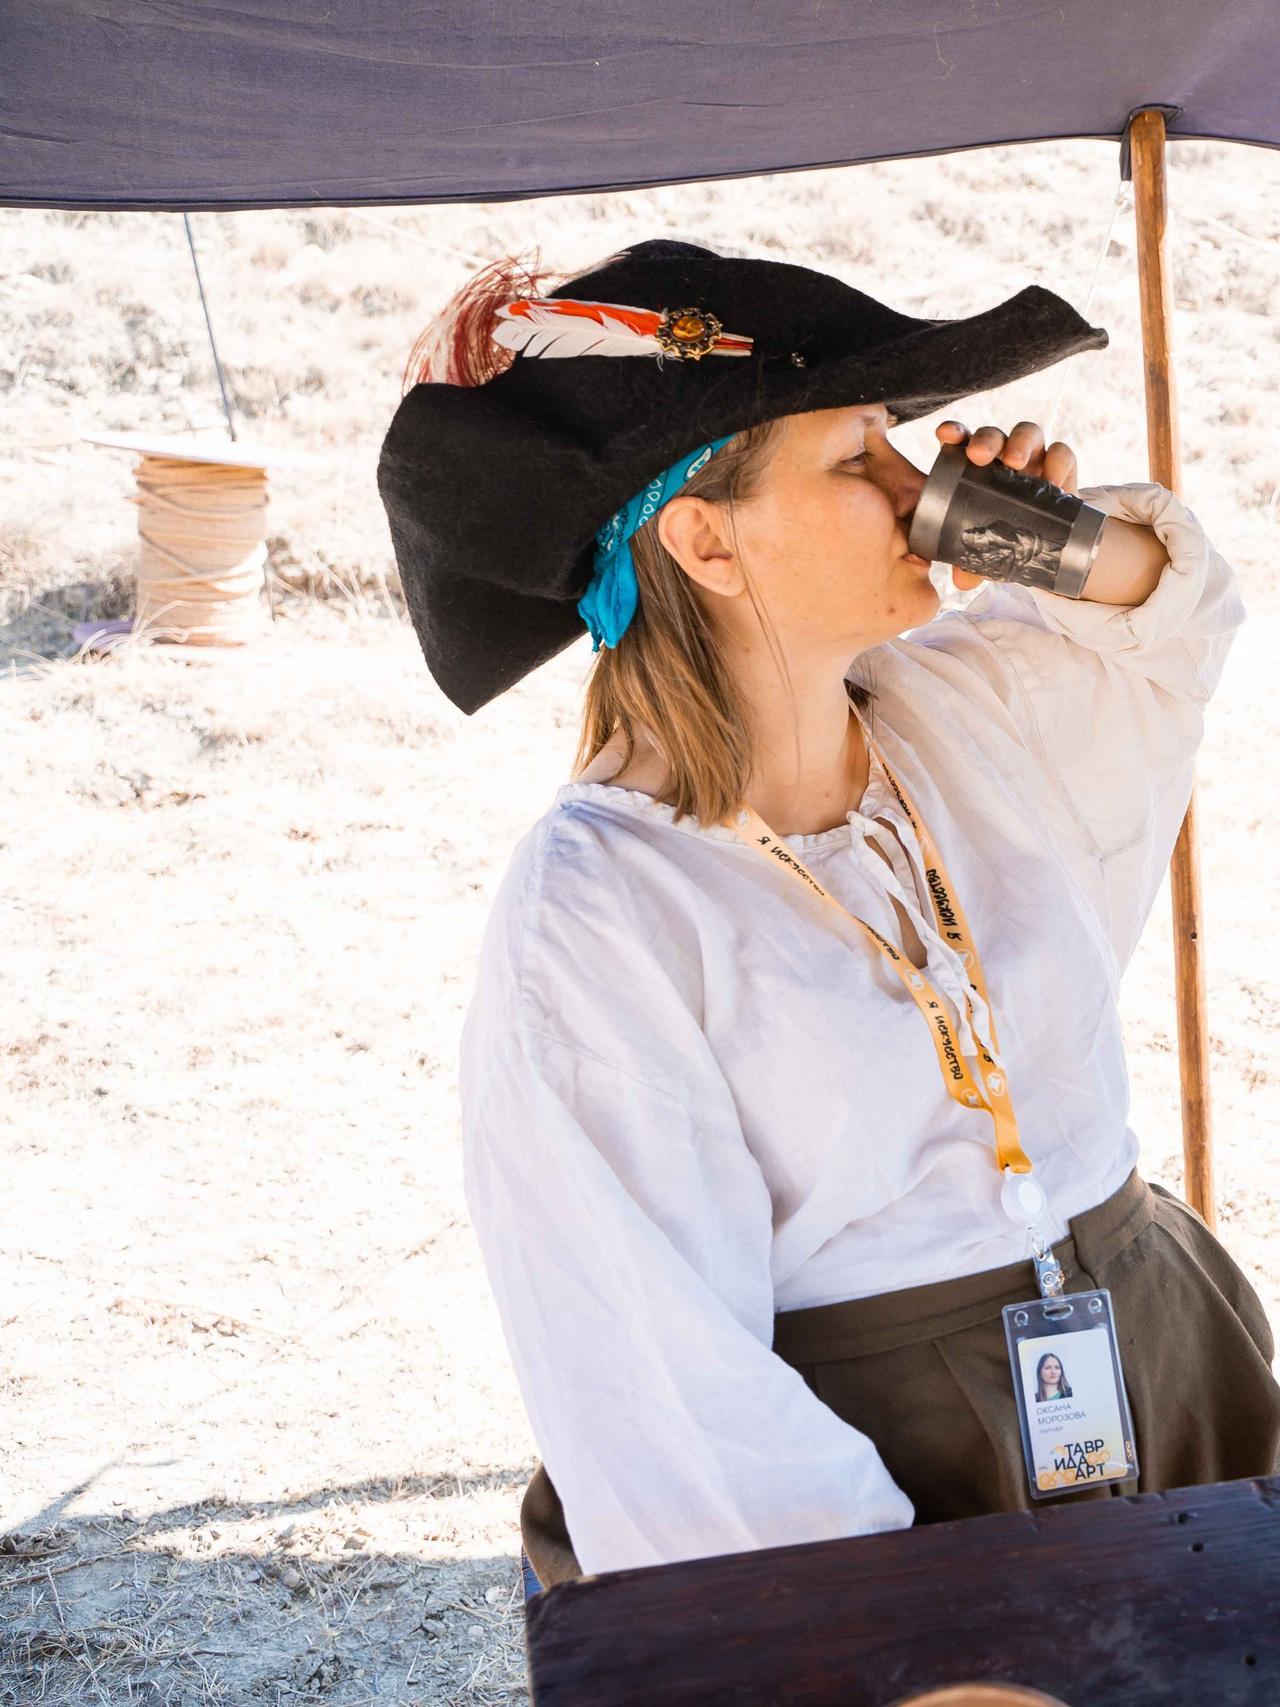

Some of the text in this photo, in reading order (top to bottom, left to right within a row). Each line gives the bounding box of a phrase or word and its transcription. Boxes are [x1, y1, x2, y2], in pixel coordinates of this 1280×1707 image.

[756, 836, 825, 897] Я ИСКУССТВО
[926, 868, 963, 942] Я ИСКУССТВО
[925, 1000, 964, 1080] Я ИСКУССТВО
[1036, 1403, 1072, 1416] ОКСАНА
[1037, 1410, 1087, 1426] МОРОЗОВА
[1064, 1439, 1105, 1457] ТАВР
[1054, 1454, 1090, 1472] ИДА
[1075, 1462, 1106, 1481] АРТ
